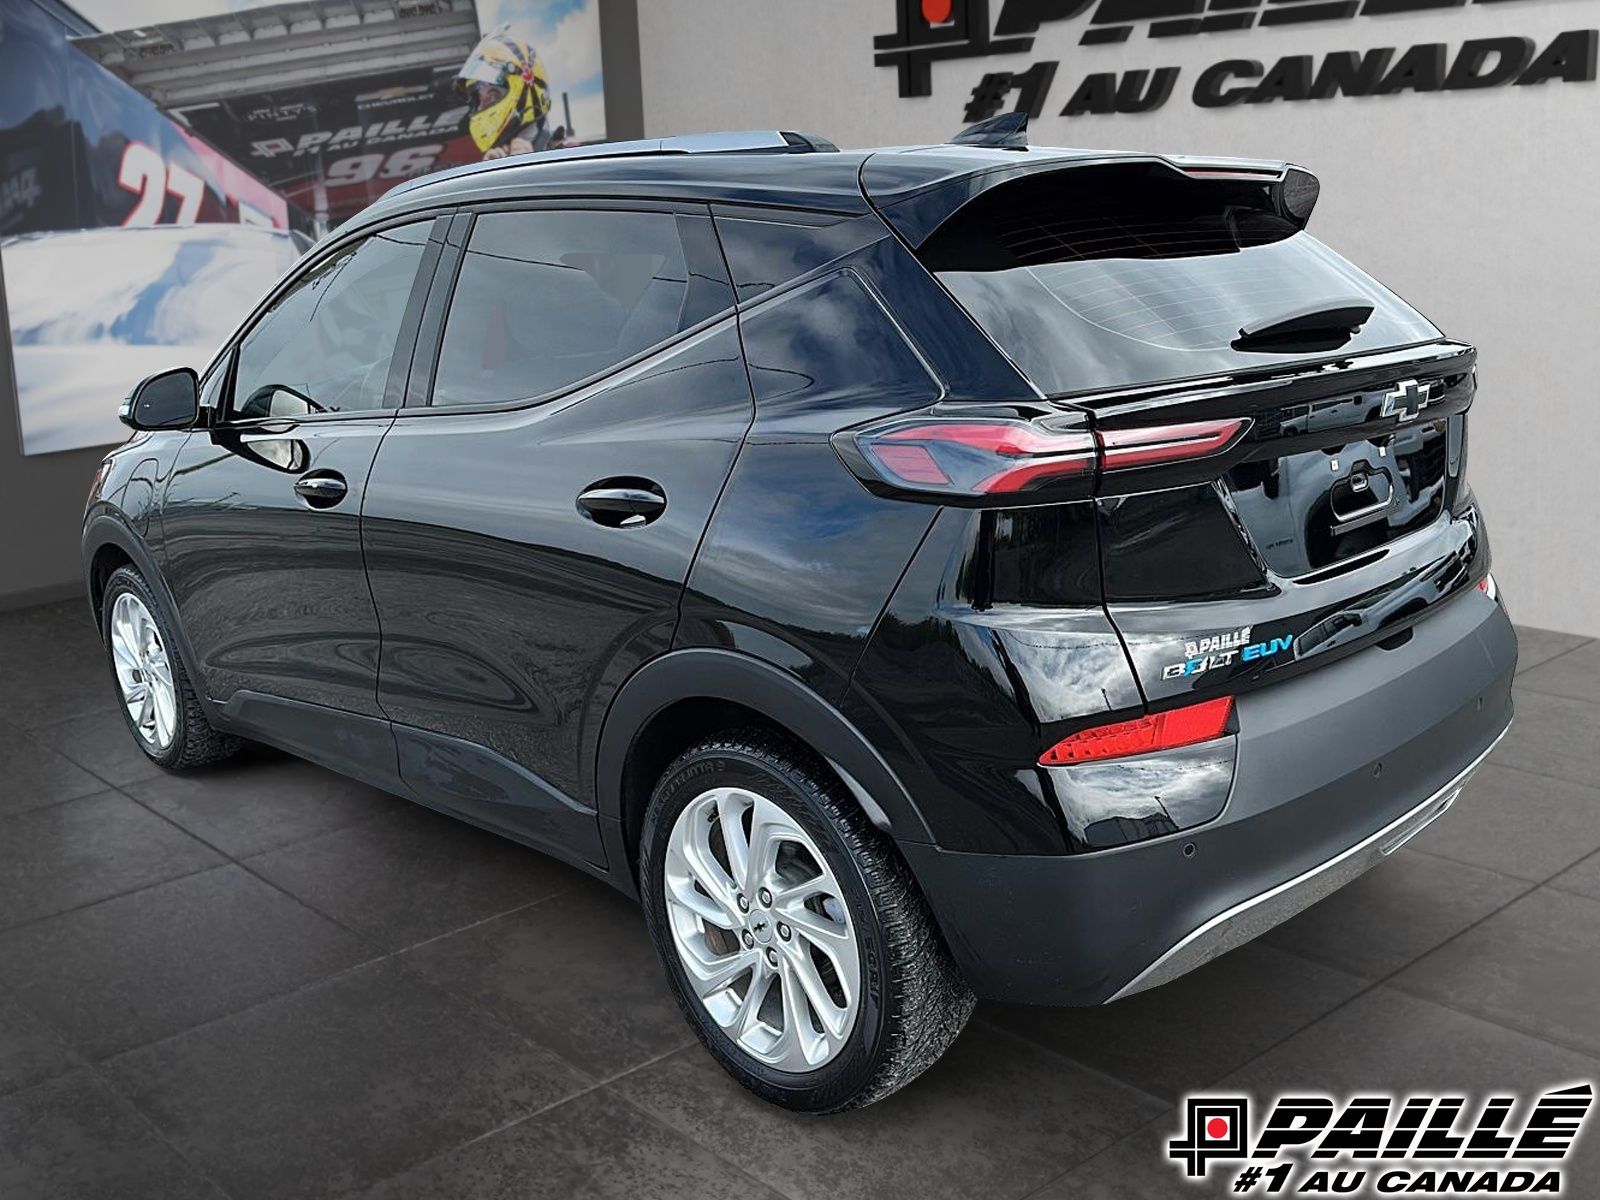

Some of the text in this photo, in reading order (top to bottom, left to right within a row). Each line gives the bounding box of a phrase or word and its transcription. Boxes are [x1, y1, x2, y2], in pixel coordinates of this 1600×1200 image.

[963, 29, 1599, 123] #1 AU CANADA
[366, 126, 458, 145] CANADA
[118, 140, 205, 227] 27
[326, 144, 444, 187] 96
[1161, 634, 1294, 681] BOLT EUV
